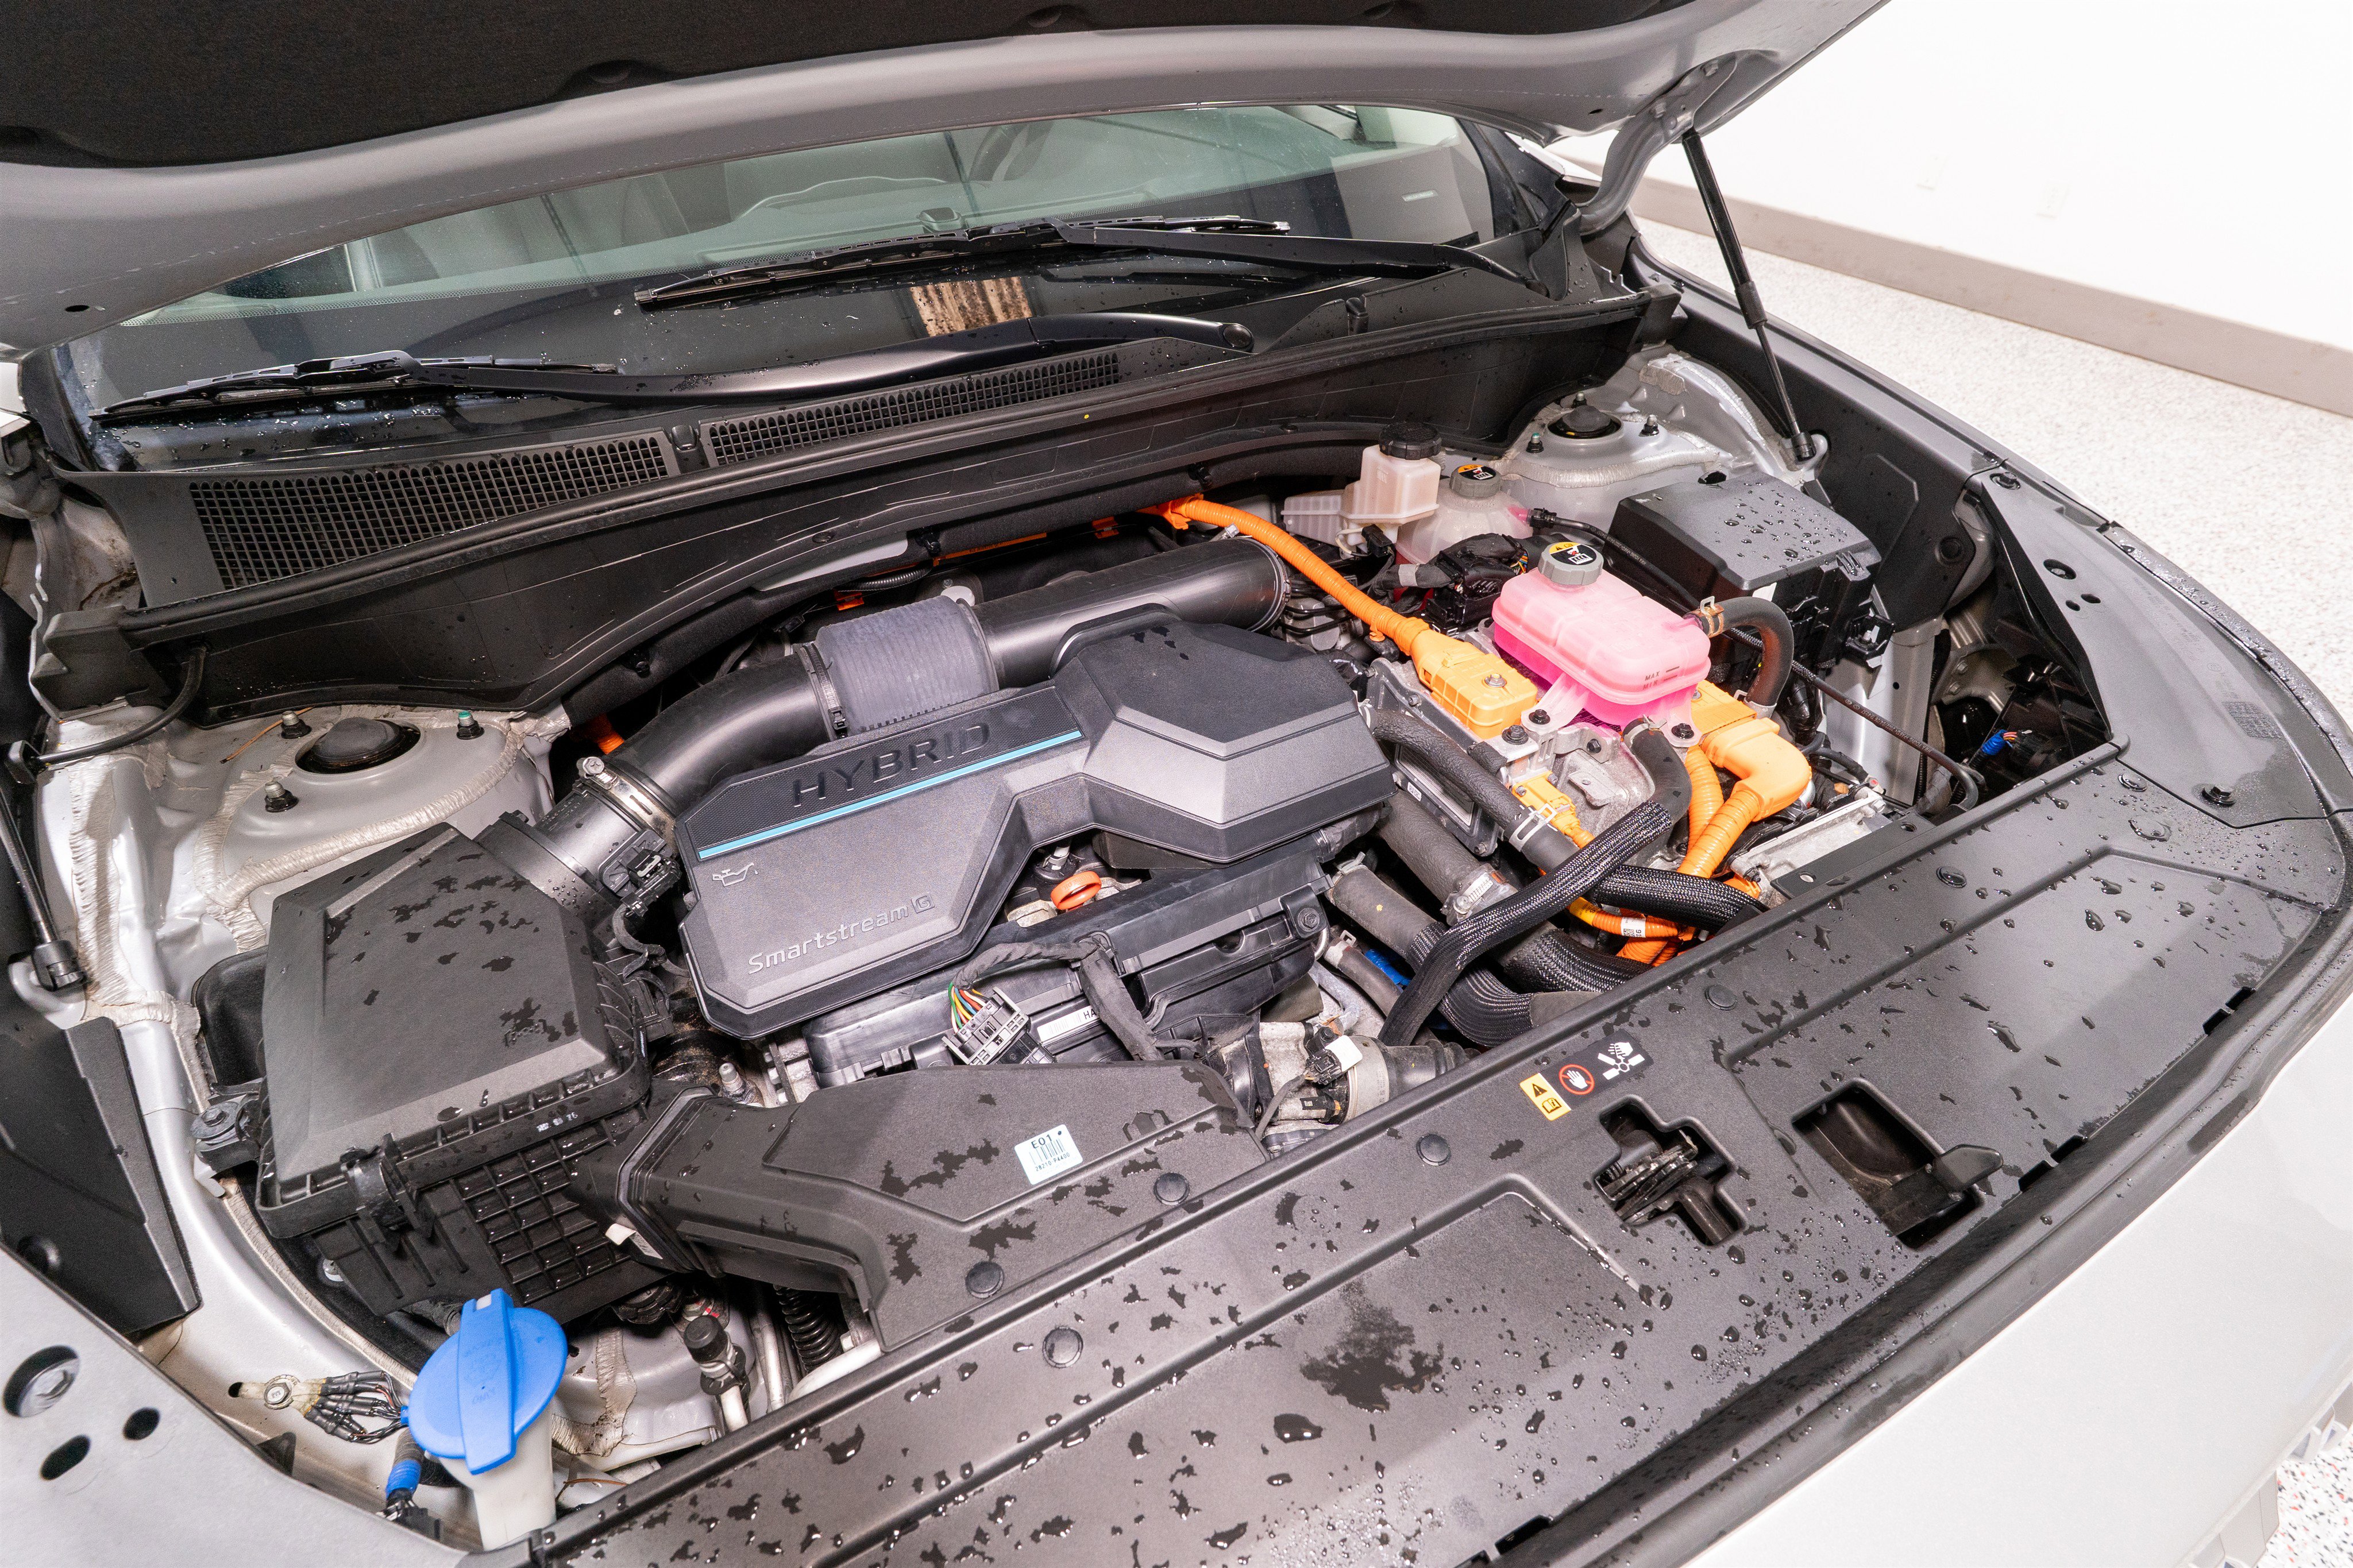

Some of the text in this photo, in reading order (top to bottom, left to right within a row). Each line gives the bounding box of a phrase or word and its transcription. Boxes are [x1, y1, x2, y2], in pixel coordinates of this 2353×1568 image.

[1645, 671, 1660, 681] MAX
[1642, 679, 1658, 690] MIN
[1910, 737, 1922, 747] YOUNG
[1922, 745, 1932, 753] HWA
[792, 721, 990, 808] HYBRID
[748, 894, 934, 974] Smartstream G
[1031, 1134, 1052, 1149] E01
[1035, 1152, 1070, 1172] 28210-P4400
